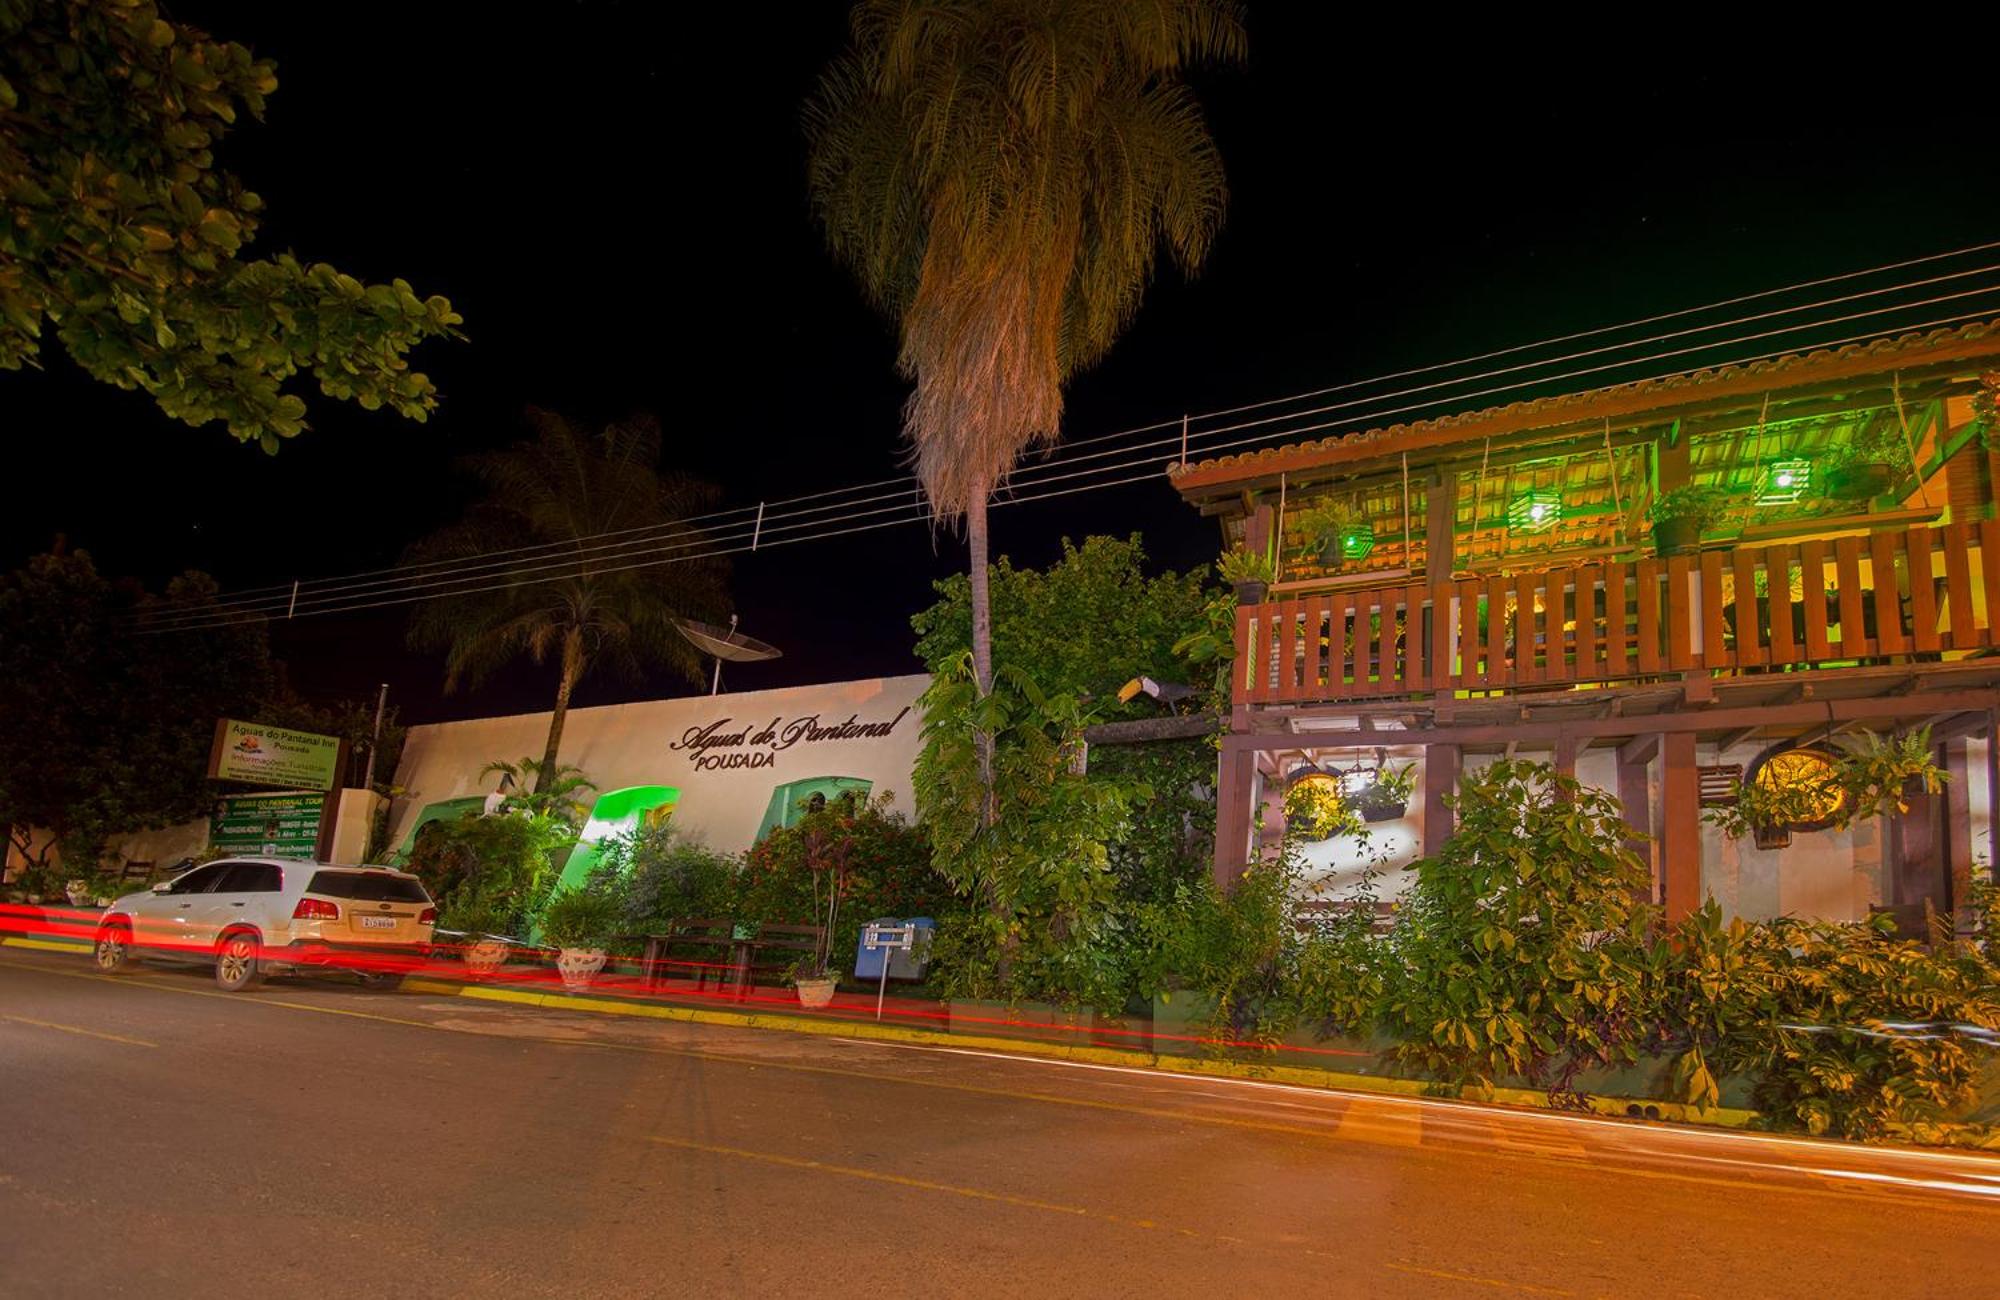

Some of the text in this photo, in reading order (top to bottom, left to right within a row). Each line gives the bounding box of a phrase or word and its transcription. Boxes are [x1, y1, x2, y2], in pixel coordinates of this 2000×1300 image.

[749, 717, 782, 745] do
[771, 706, 911, 750] Pantanal
[266, 730, 279, 739] do
[280, 731, 320, 746] Pantanal
[322, 738, 336, 748] Inn
[274, 742, 310, 753] Pousada
[694, 752, 775, 772] POUSADA
[268, 798, 303, 808] PANTANAL
